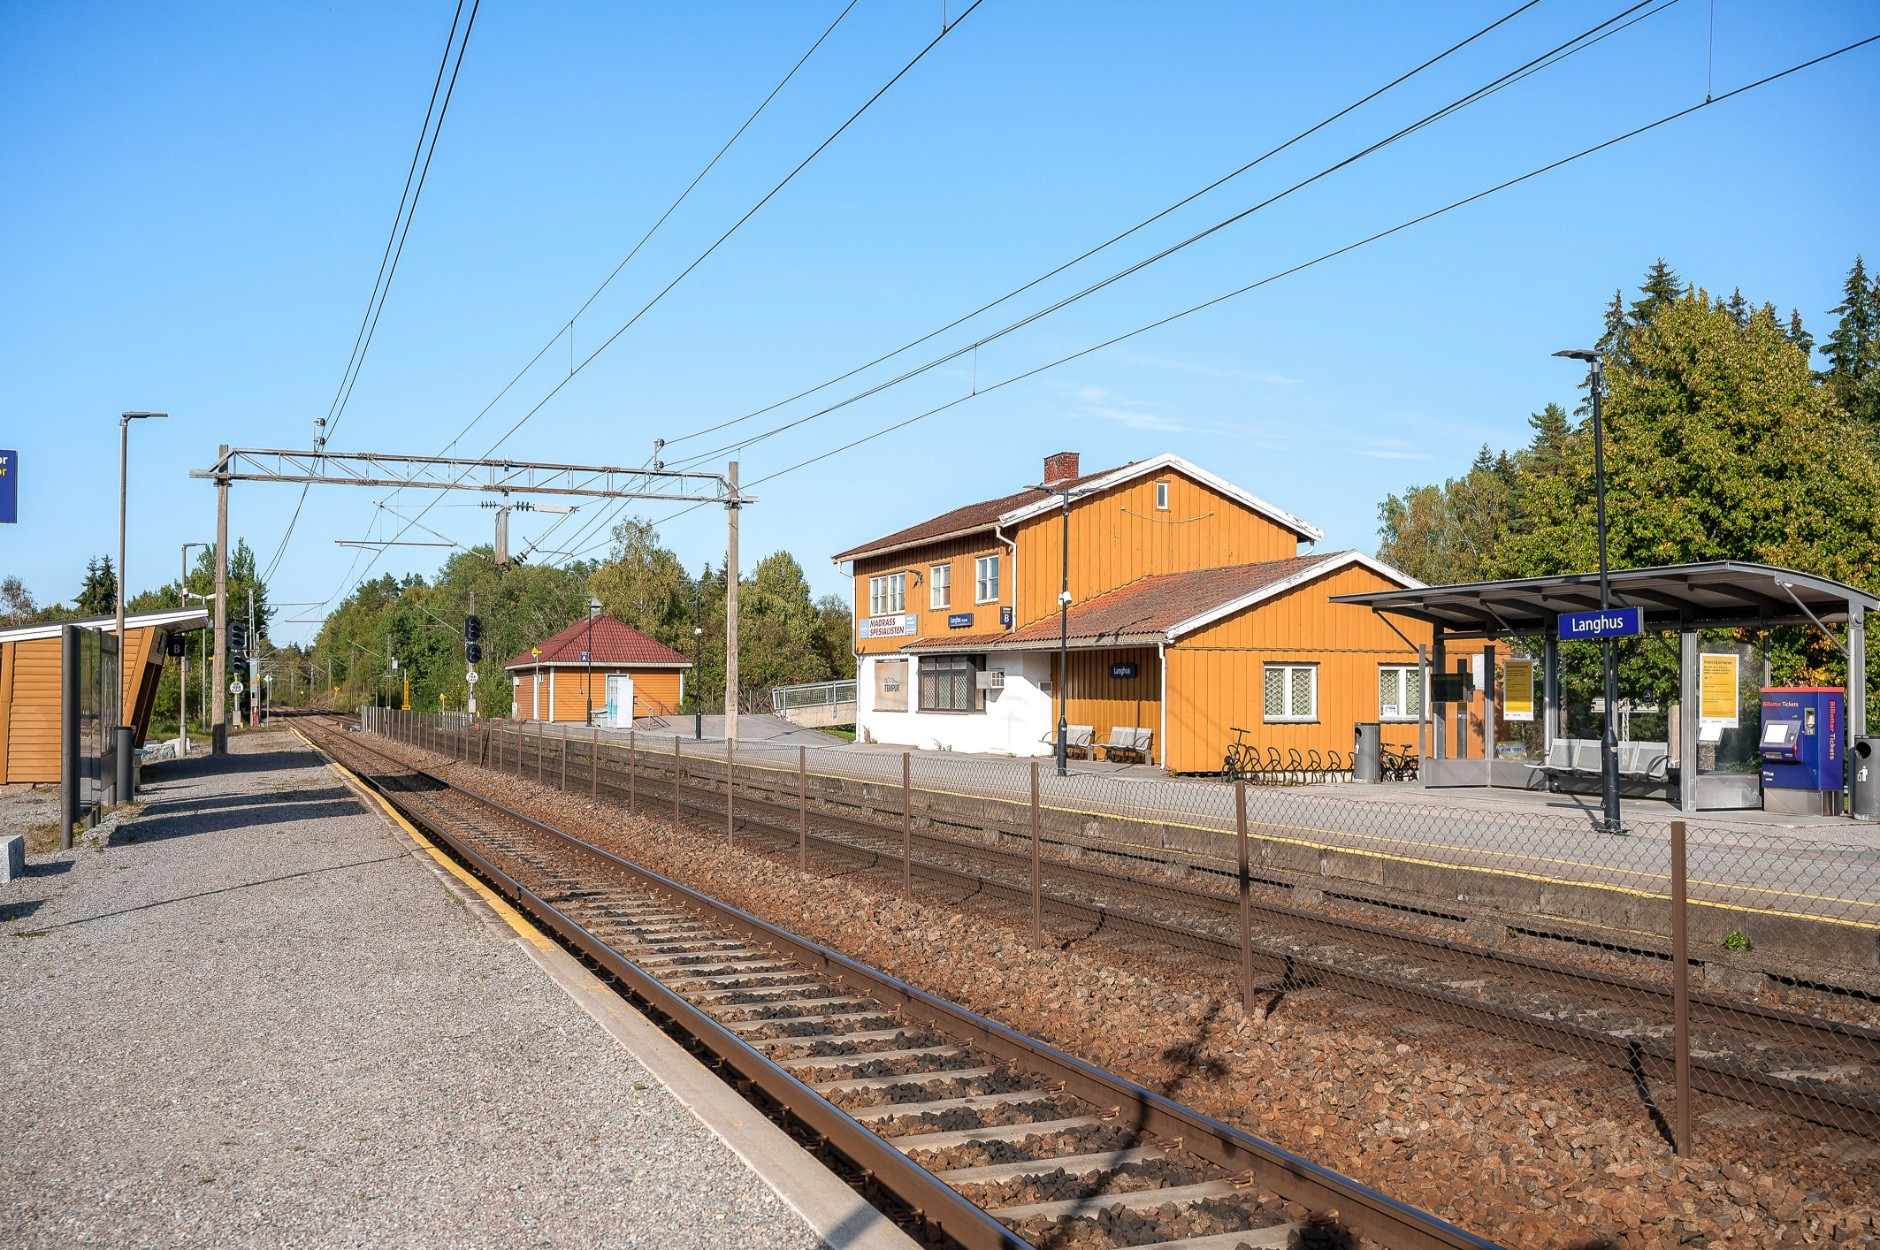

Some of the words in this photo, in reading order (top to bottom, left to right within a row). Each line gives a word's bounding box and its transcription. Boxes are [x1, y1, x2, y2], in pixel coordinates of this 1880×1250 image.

[869, 617, 896, 628] MADRASS
[1004, 614, 1010, 622] B
[1572, 615, 1624, 634] Langhus
[869, 626, 905, 637] SPESIALISTEN
[173, 644, 181, 654] B
[1113, 667, 1130, 676] Langhus
[884, 684, 900, 692] TEMPUR
